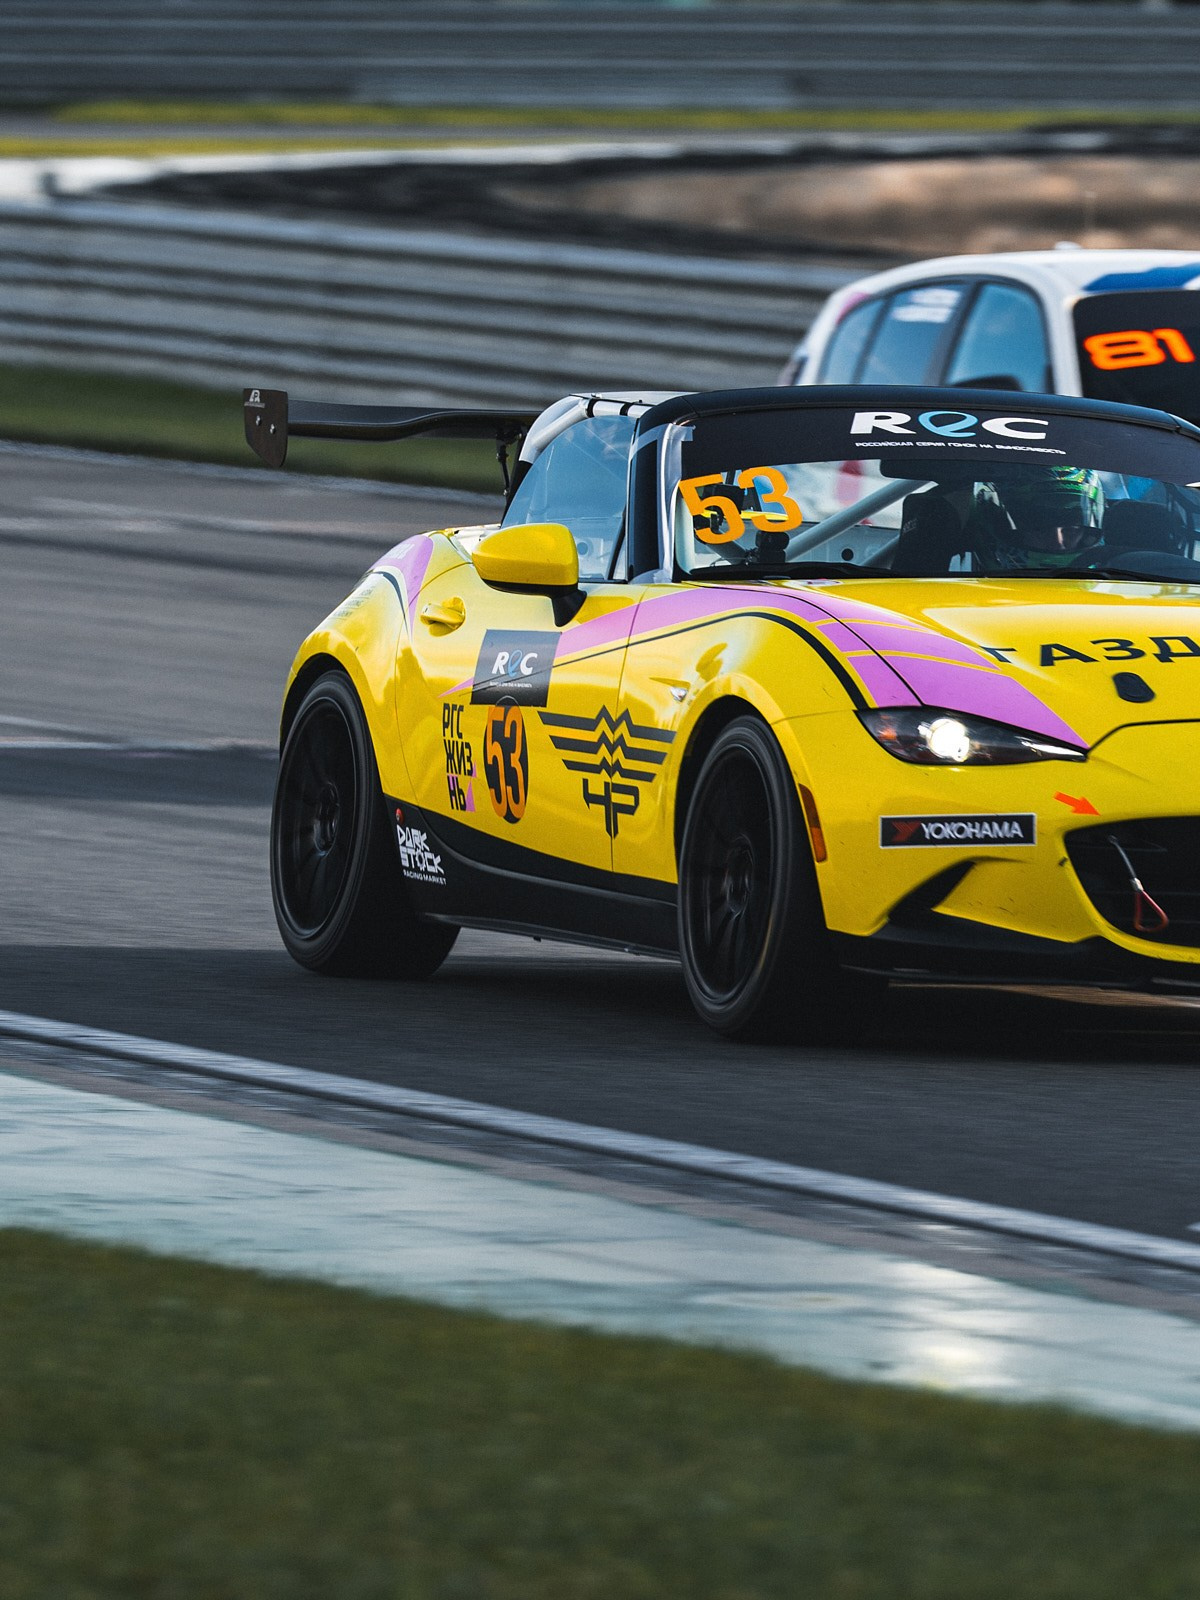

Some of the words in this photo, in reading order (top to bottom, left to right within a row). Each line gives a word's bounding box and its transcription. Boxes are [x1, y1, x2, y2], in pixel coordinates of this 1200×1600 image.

[1083, 328, 1196, 371] 81
[678, 466, 803, 545] 53
[442, 702, 464, 740] РГС
[486, 705, 527, 819] 53
[396, 824, 430, 852] DARK
[921, 821, 1024, 840] YOKOHAMA
[399, 845, 445, 875] STOCK
